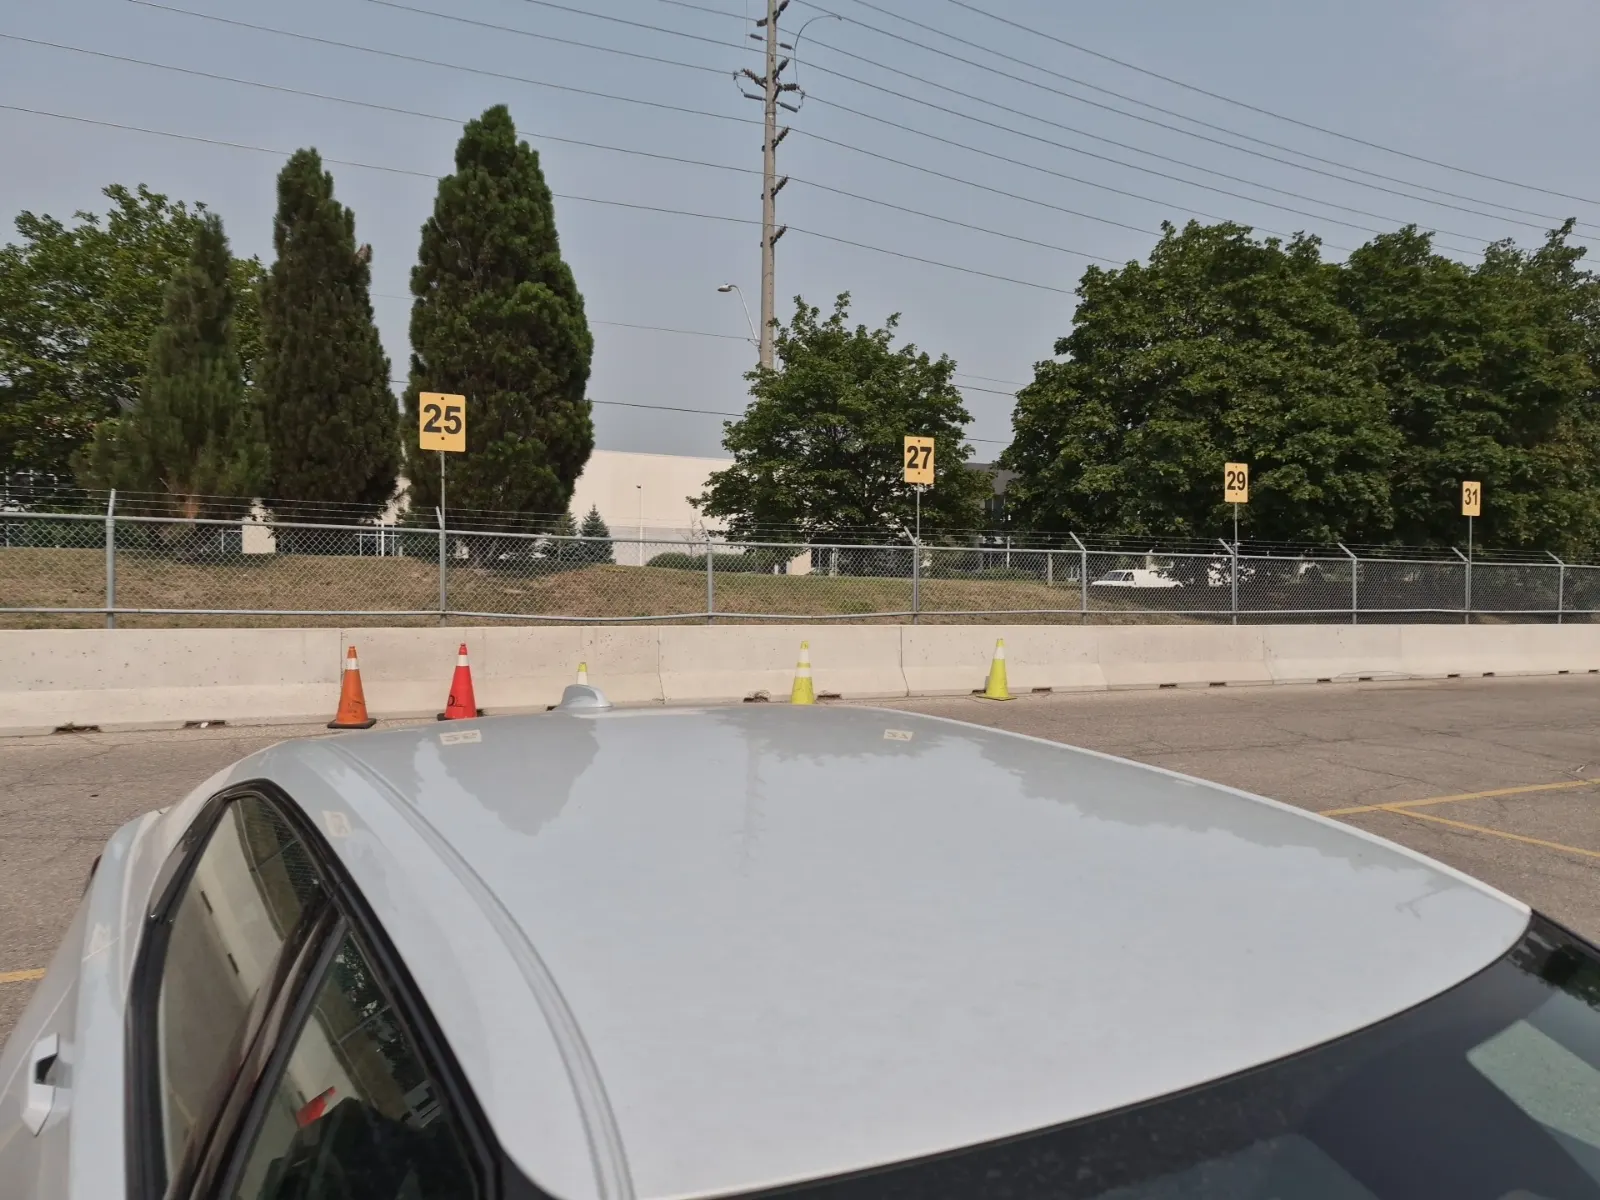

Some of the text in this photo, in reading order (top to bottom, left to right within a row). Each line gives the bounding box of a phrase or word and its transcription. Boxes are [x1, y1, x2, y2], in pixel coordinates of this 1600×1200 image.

[423, 403, 463, 435] 25
[906, 445, 933, 470] 27
[1227, 470, 1247, 491] 29
[1464, 487, 1479, 506] 31
